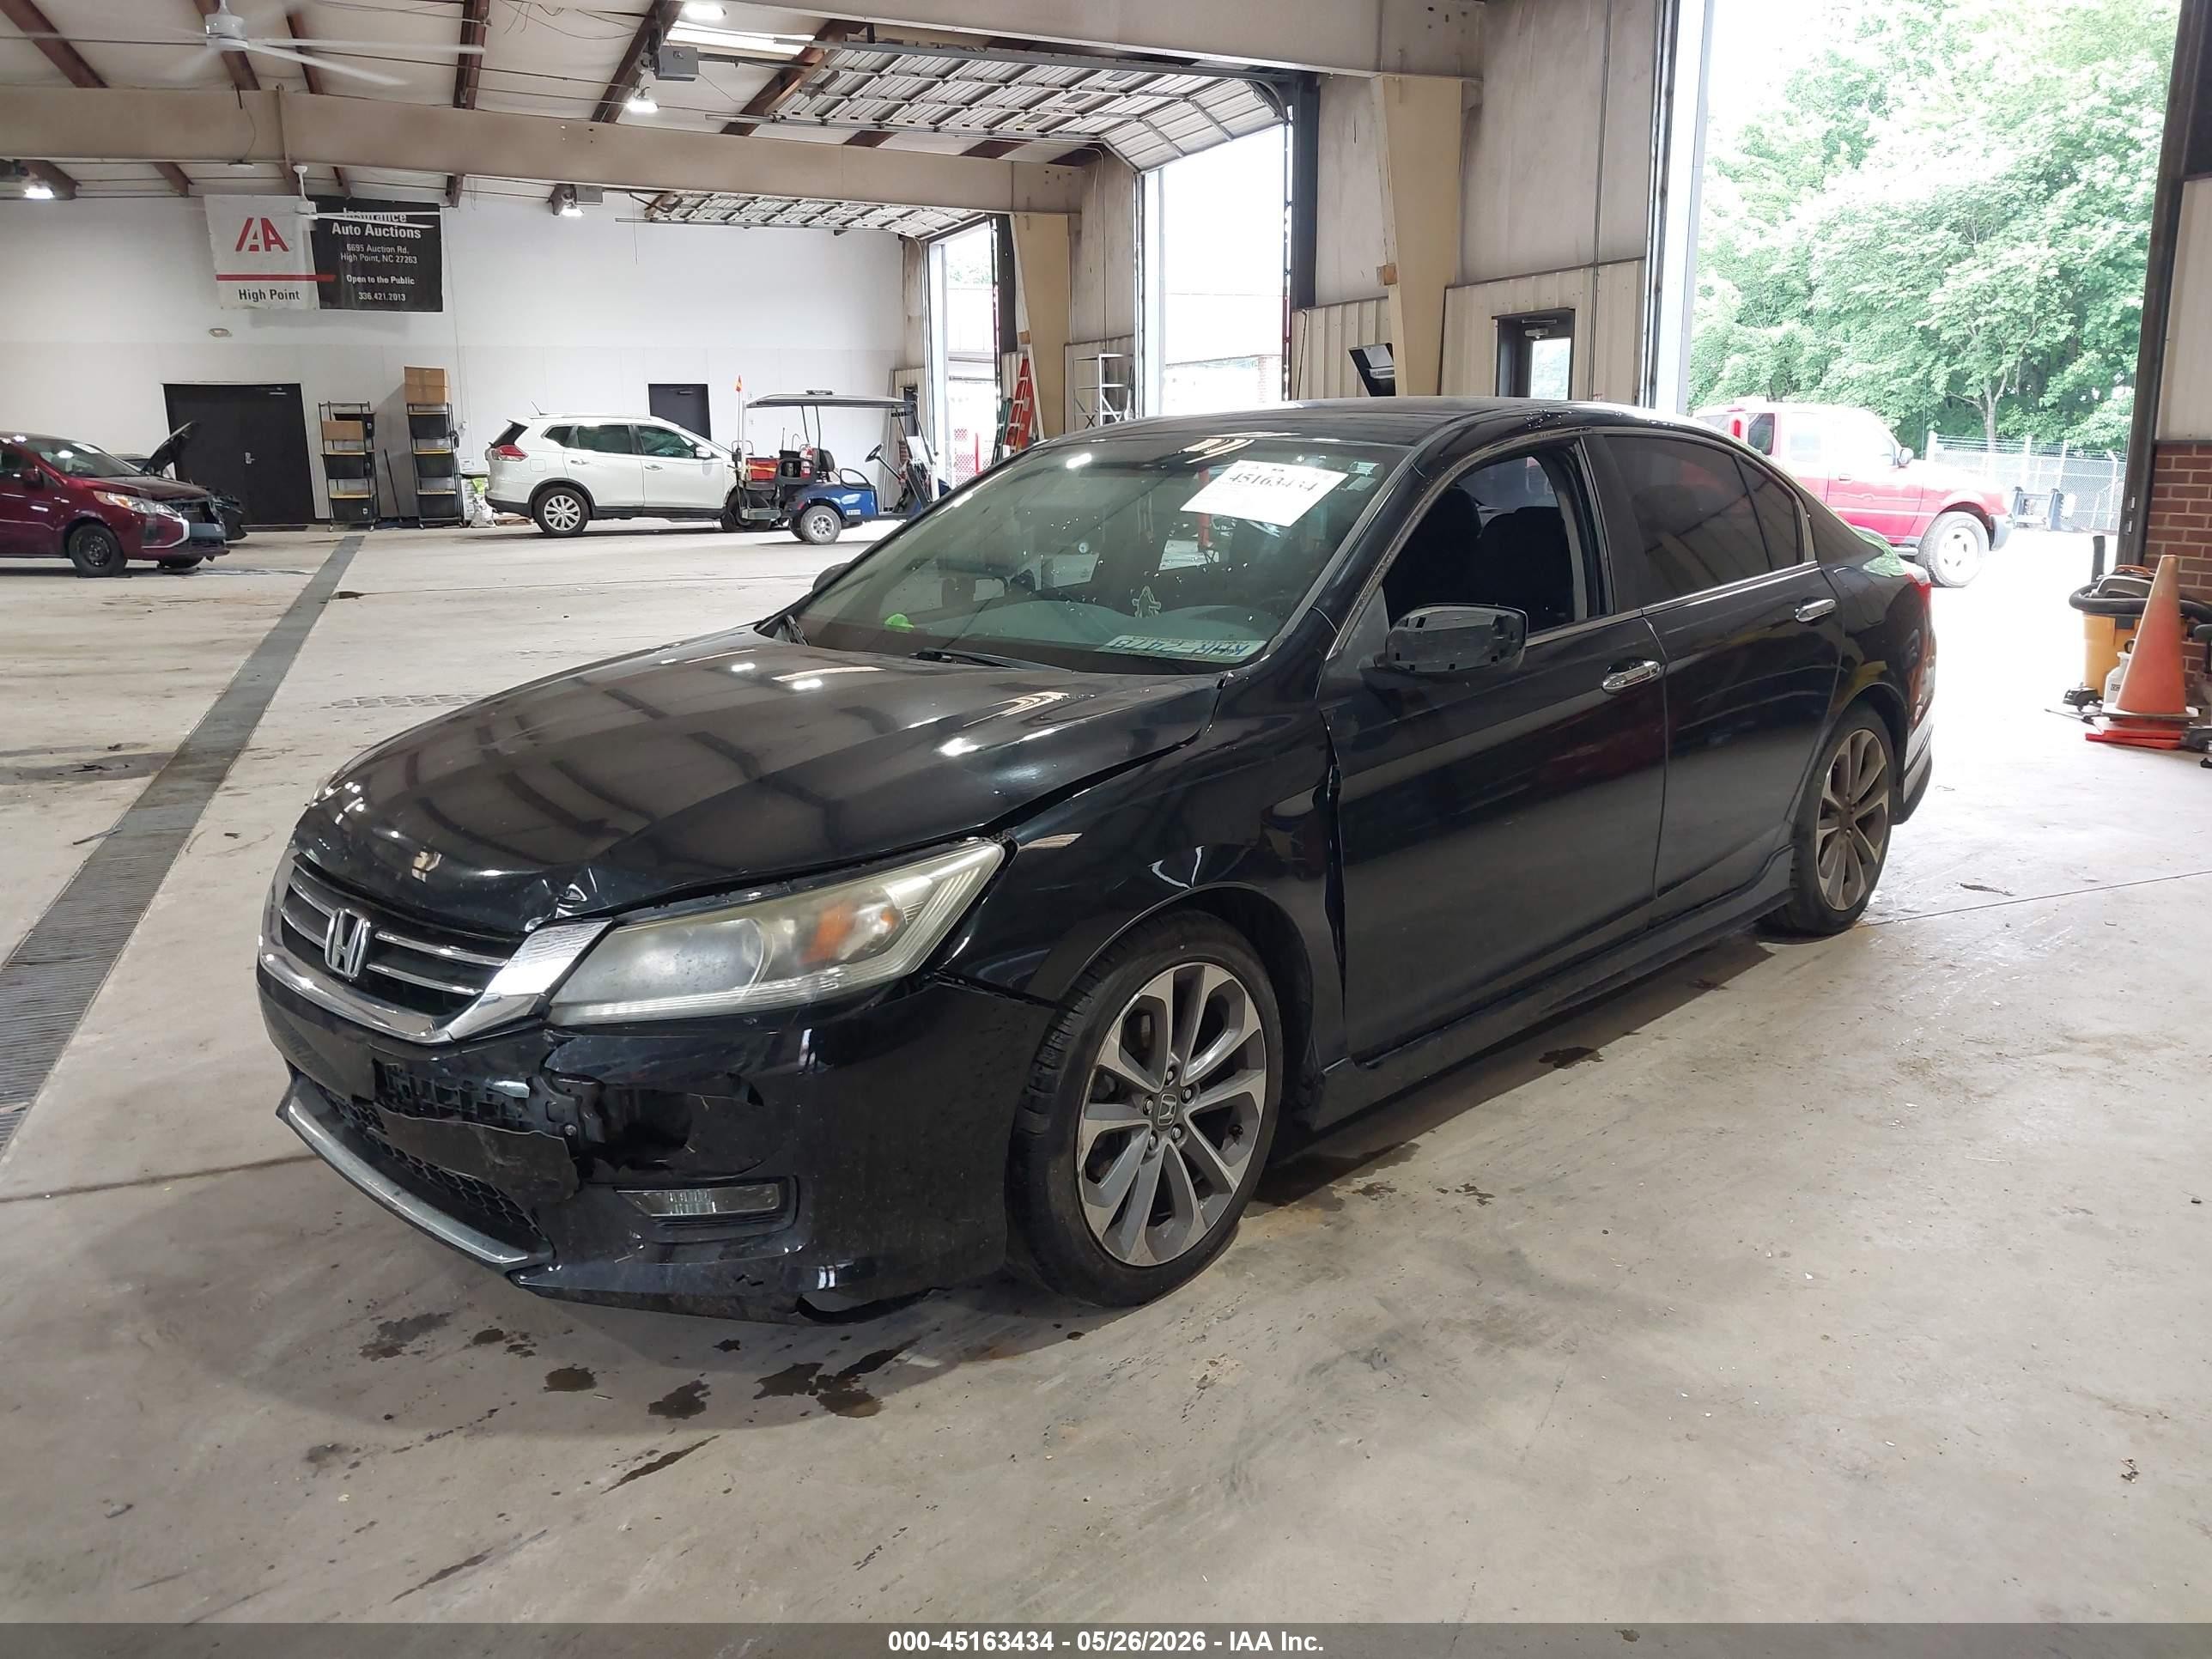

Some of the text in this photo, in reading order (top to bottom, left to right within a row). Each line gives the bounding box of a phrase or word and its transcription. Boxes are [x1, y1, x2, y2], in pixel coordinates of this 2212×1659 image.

[331, 222, 422, 239] Auto Auctions
[346, 243, 365, 252] 6695
[366, 244, 395, 253] Auction
[340, 252, 417, 264] High Point, NC 27263
[346, 274, 366, 284] Open
[376, 275, 389, 283] the
[390, 276, 416, 285] Public
[239, 289, 301, 302] High Point
